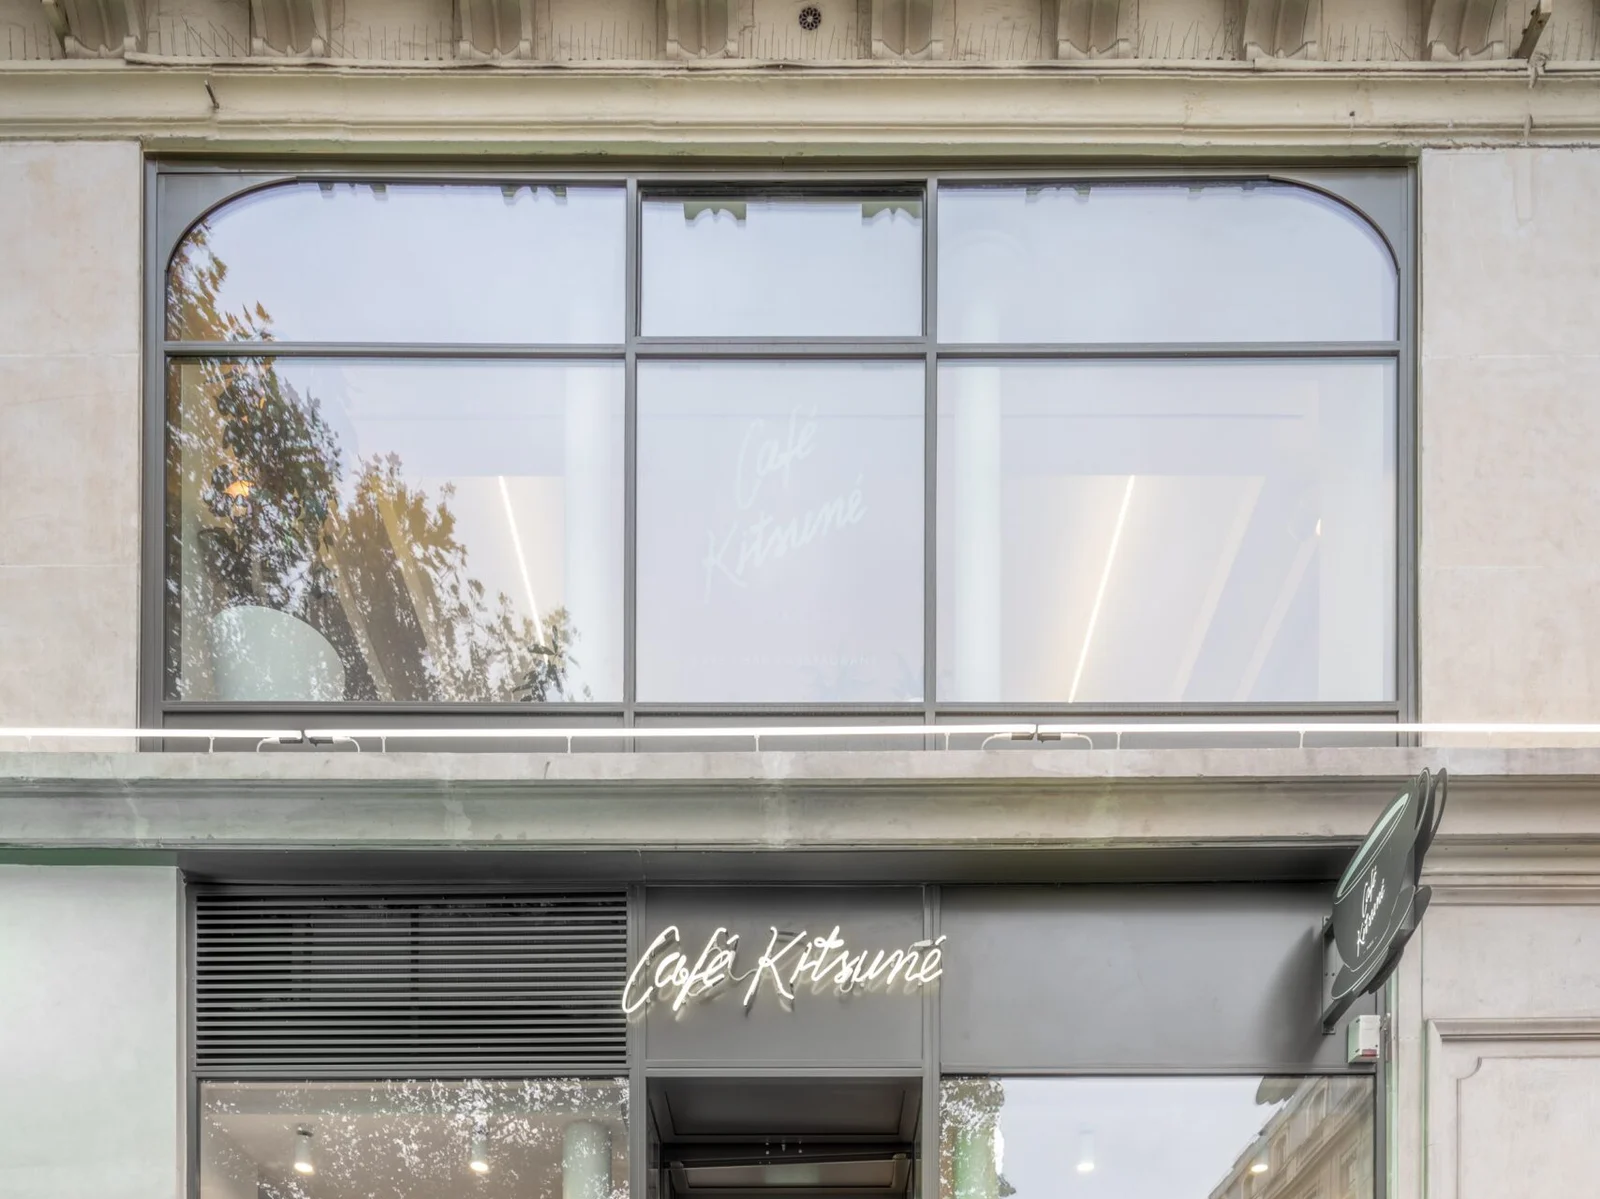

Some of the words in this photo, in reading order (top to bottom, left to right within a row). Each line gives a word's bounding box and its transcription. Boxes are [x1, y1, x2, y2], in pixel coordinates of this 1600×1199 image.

[736, 403, 818, 510] Café
[702, 472, 868, 605] Kitsuné
[622, 925, 740, 1014] Café
[743, 925, 947, 1007] Kitsuné
